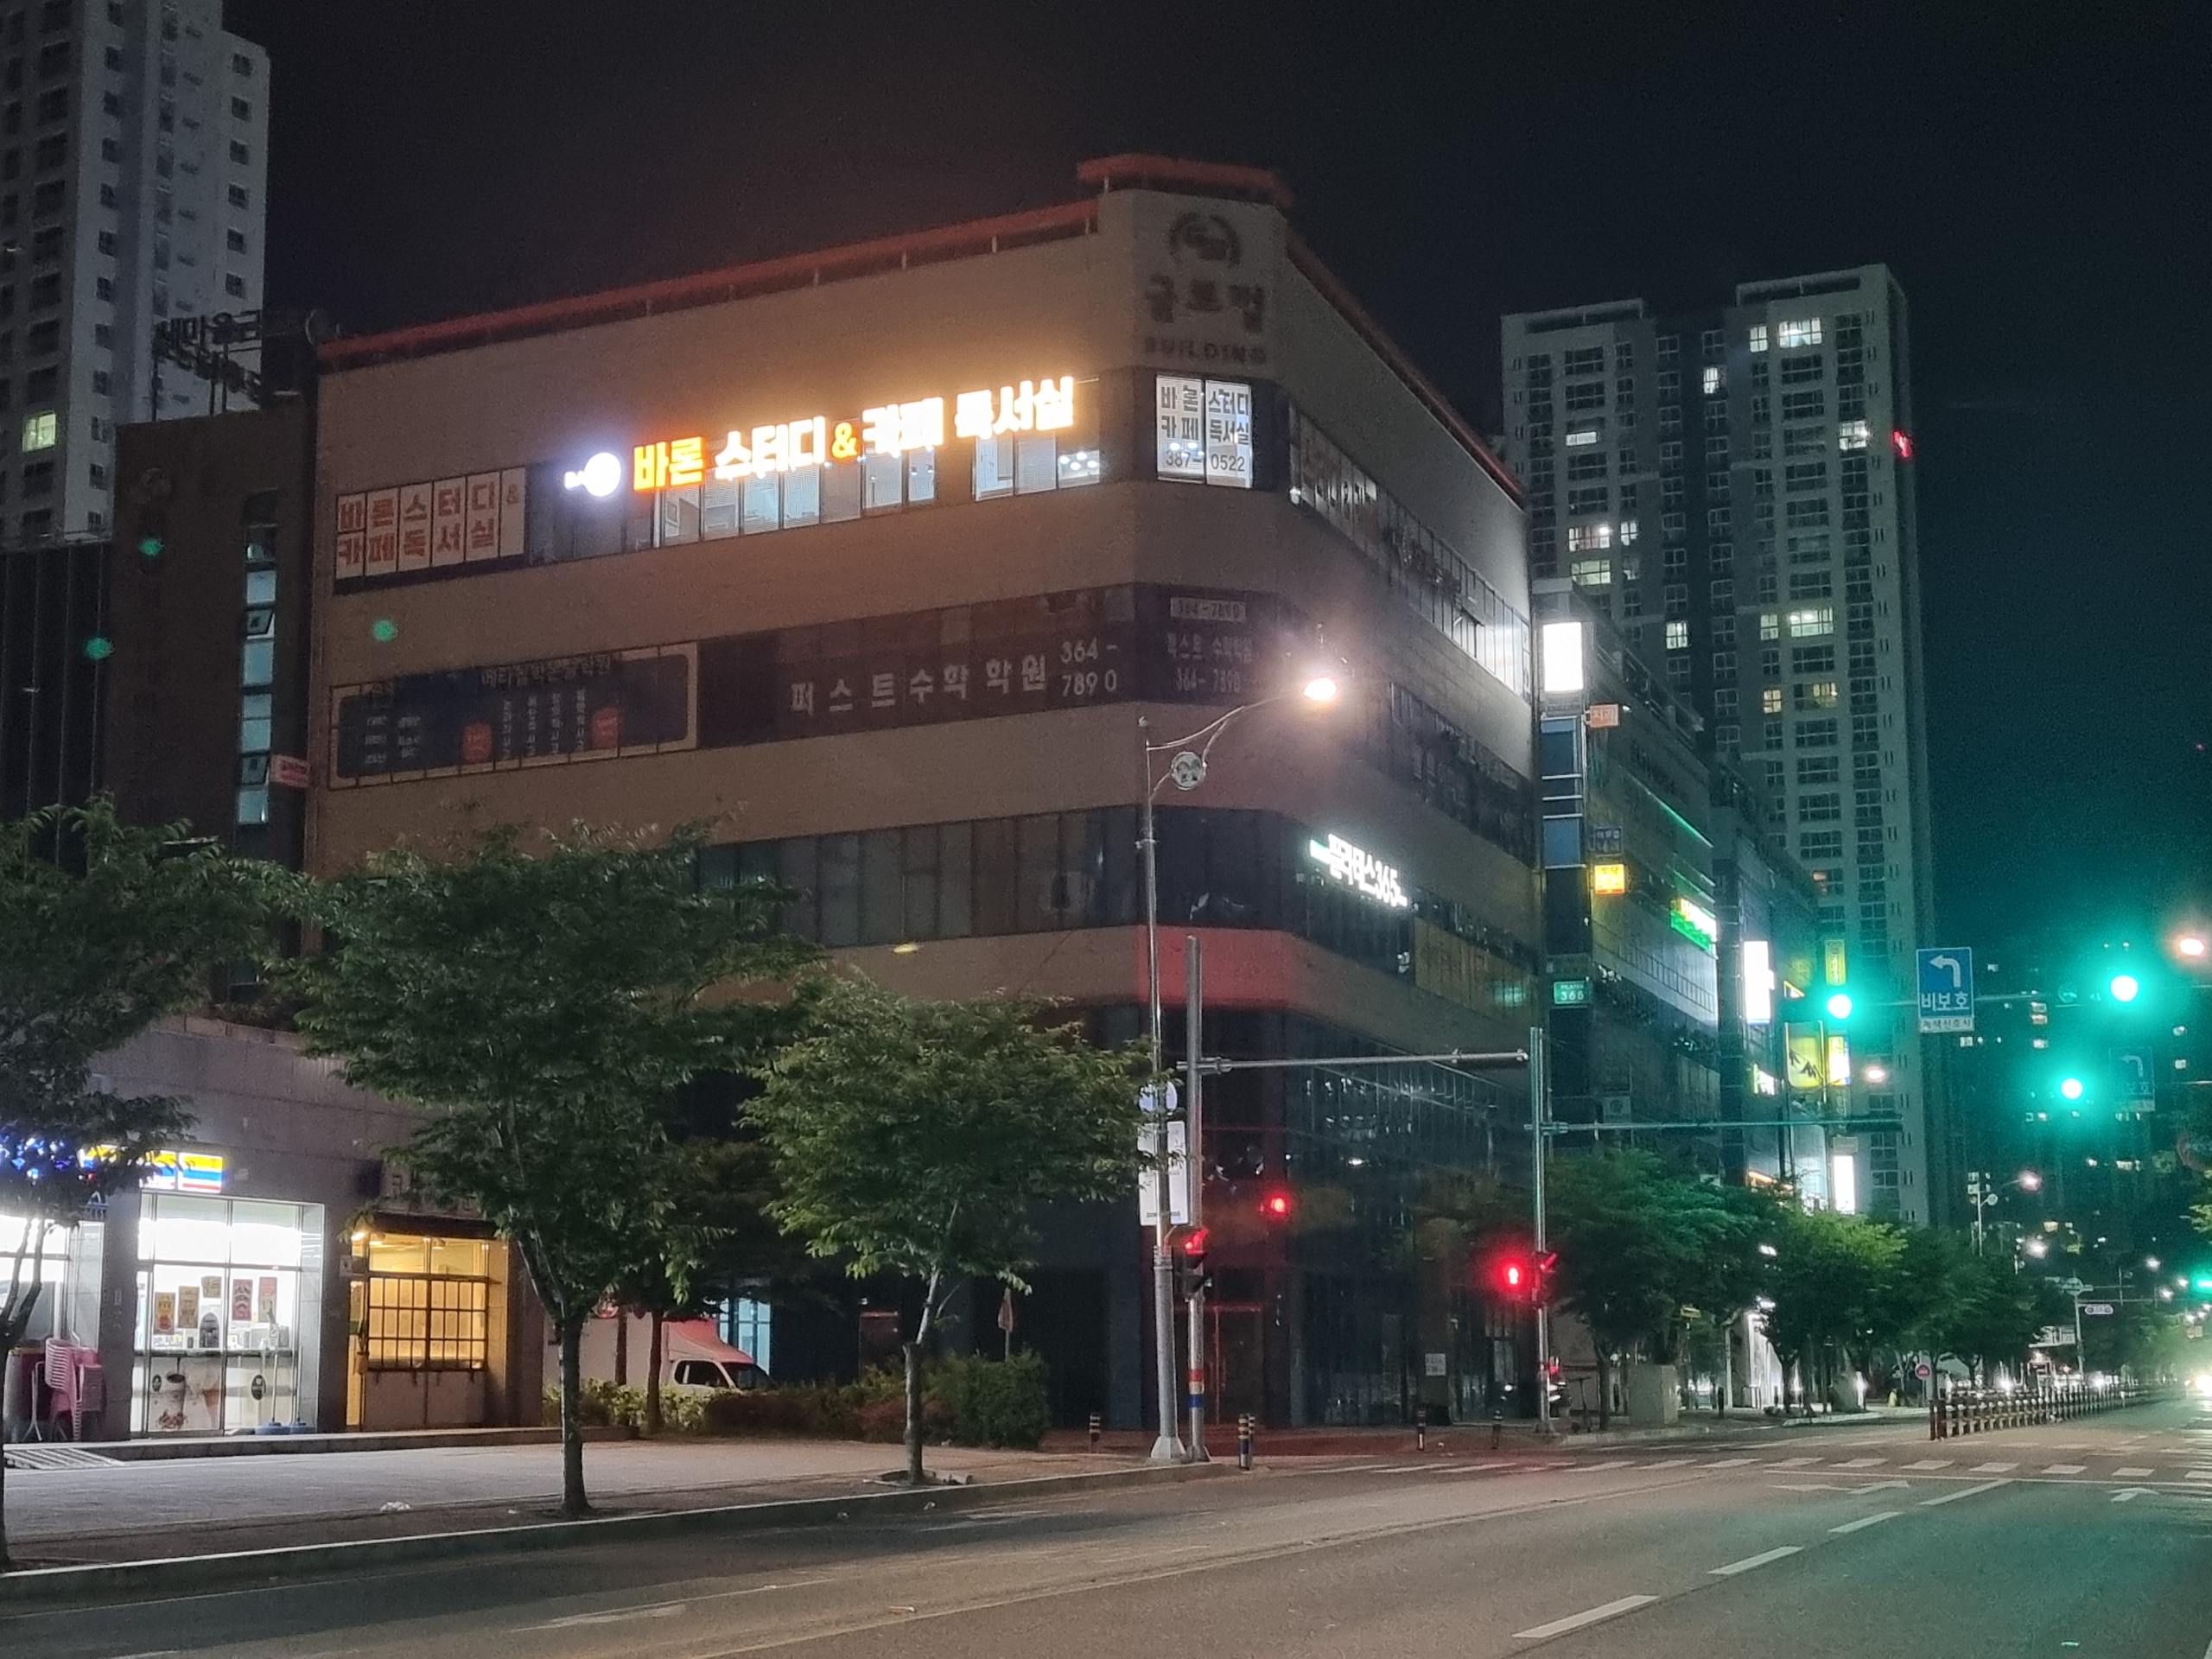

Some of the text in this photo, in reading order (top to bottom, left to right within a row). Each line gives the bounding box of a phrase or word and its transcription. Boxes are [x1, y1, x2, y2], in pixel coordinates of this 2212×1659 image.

[1144, 335, 1267, 365] BUILDING
[634, 436, 703, 491] 바론
[715, 416, 826, 480] 스터디
[831, 422, 858, 459] &
[955, 376, 1074, 439] 독서실
[1061, 669, 1117, 696] 7890
[1921, 991, 1970, 1012] 비보호
